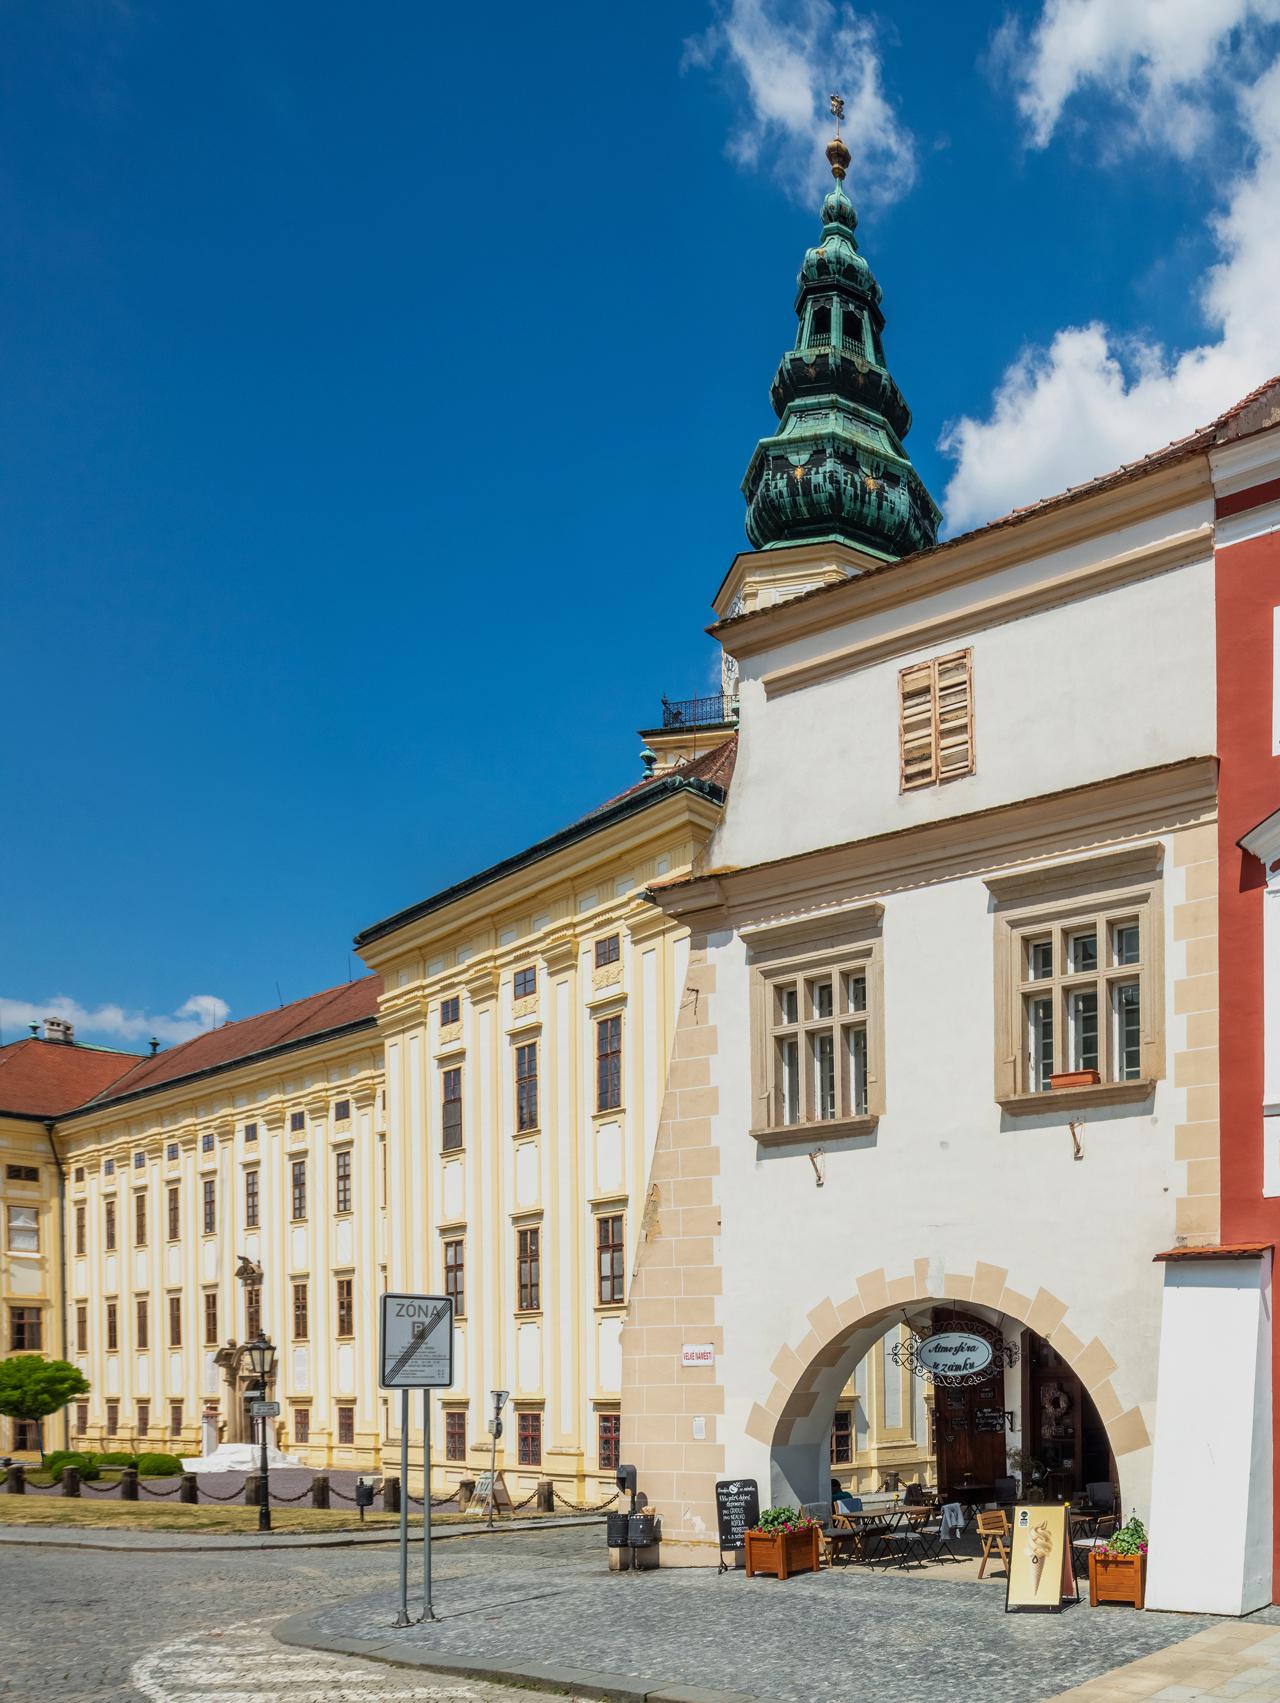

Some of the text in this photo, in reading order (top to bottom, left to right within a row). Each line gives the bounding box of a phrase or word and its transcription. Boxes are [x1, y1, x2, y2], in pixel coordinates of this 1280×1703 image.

[395, 1300, 441, 1318] ZÓNA
[929, 1342, 979, 1356] Atmosféra
[933, 1357, 975, 1373] u zámku
